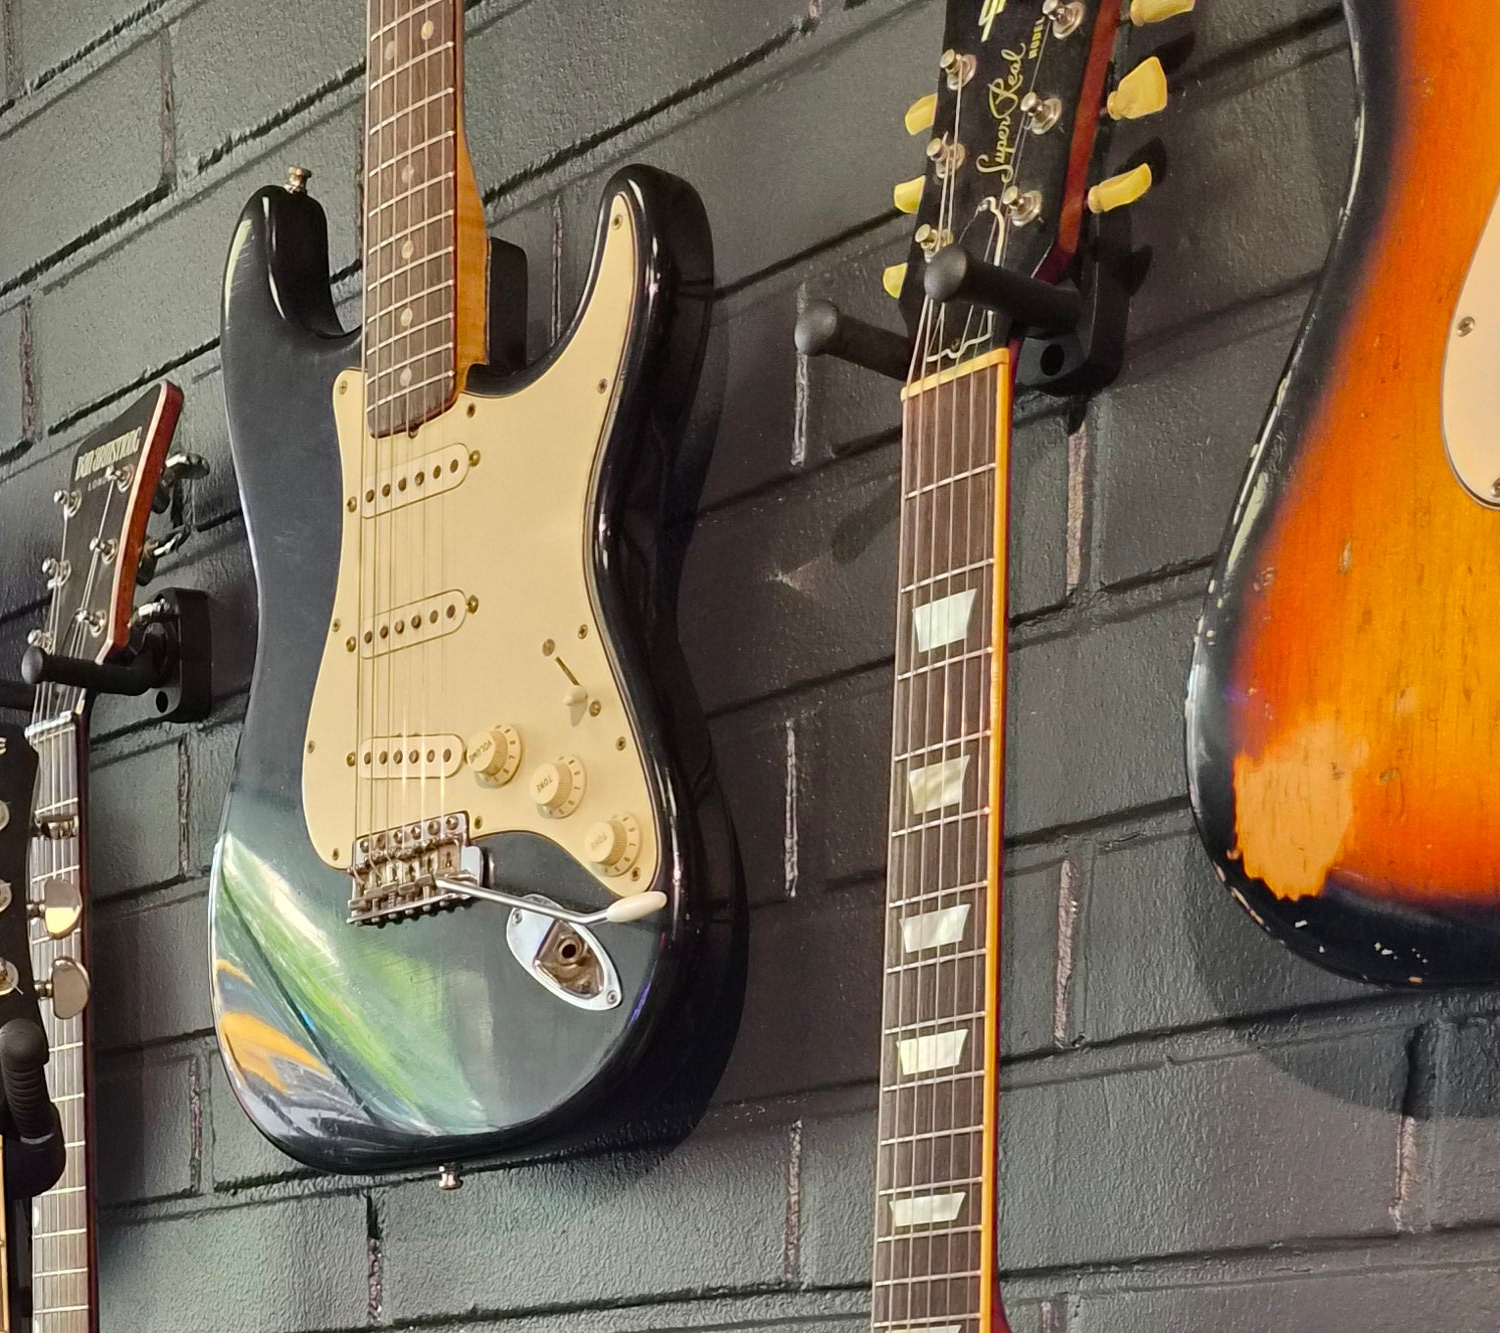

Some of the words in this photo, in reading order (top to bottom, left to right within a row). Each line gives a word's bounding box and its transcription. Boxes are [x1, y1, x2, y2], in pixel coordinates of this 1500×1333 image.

[988, 43, 1026, 119] Real
[976, 116, 1017, 183] Super
[469, 740, 492, 763] VOLUME
[536, 775, 553, 793] TONE
